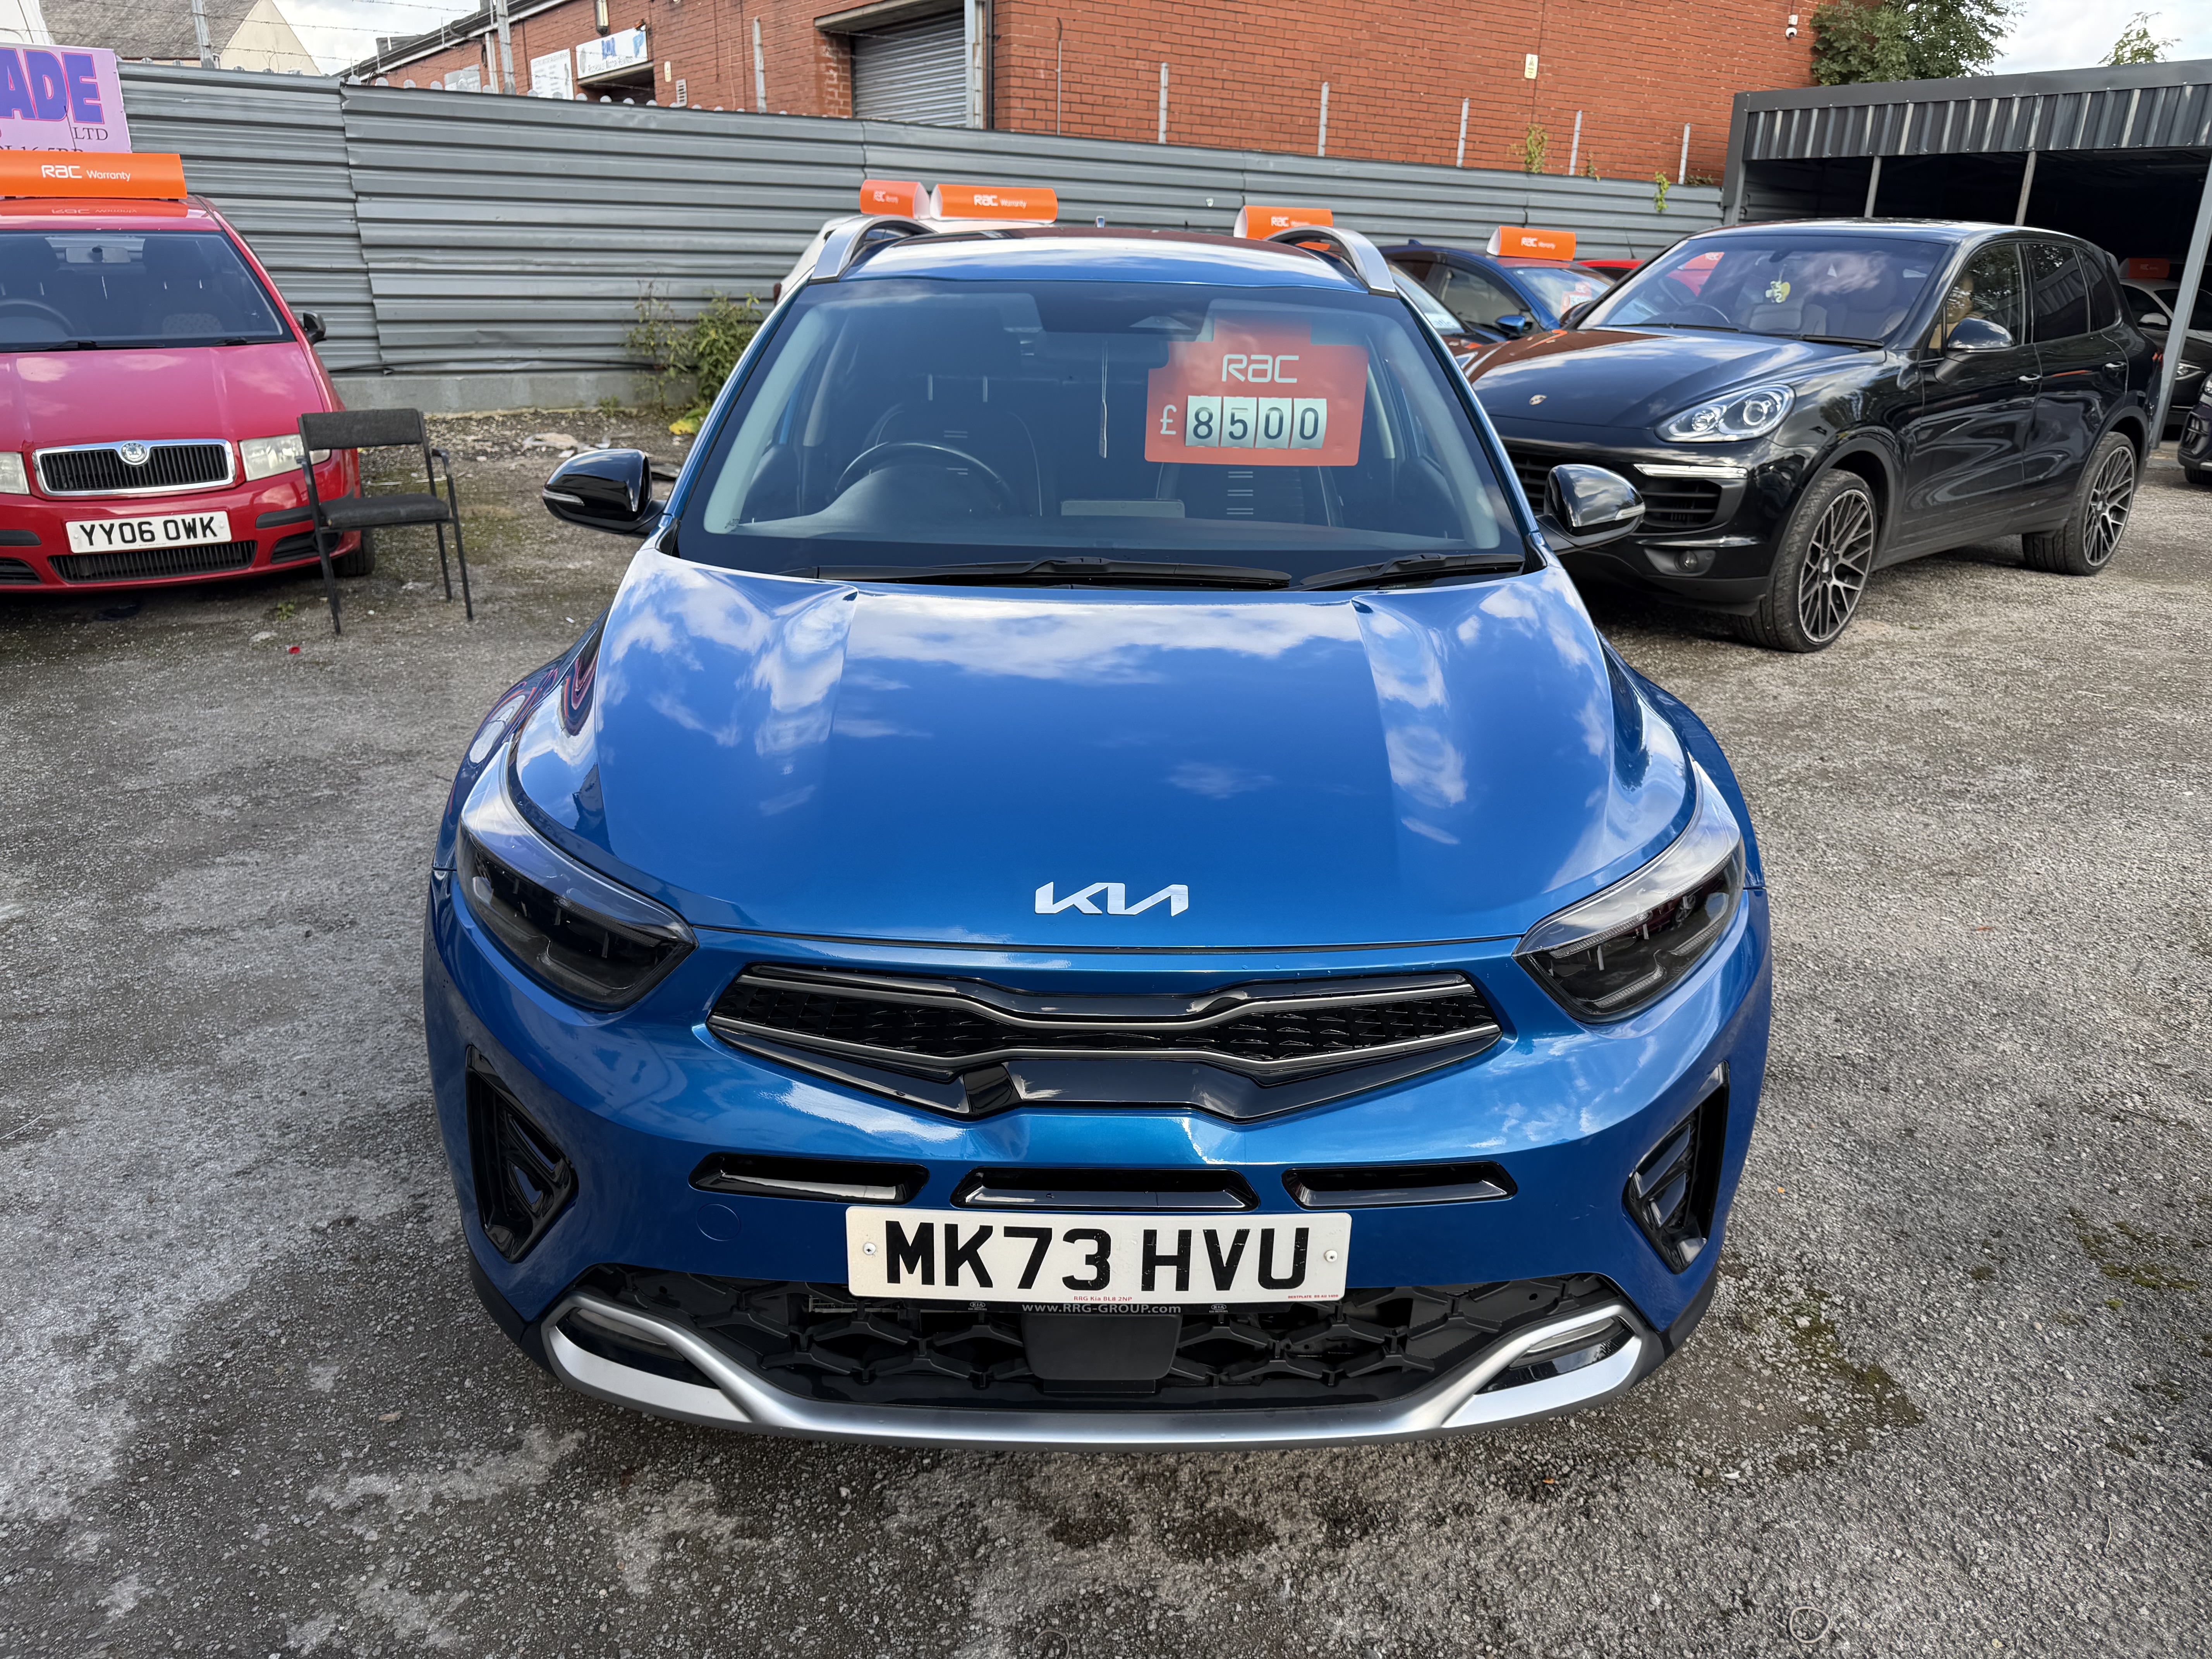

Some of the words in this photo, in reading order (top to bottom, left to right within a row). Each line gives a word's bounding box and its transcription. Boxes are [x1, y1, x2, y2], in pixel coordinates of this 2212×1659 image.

[73, 127, 108, 141] LTD
[41, 165, 82, 179] RAC
[86, 170, 131, 182] Warranty
[974, 194, 998, 206] RAC
[999, 198, 1027, 209] Warranty
[1271, 216, 1289, 227] RAC
[1221, 354, 1299, 383] RAC
[79, 521, 155, 546] YY06
[163, 516, 217, 541] OWK
[1035, 881, 1188, 917] KIA
[886, 1220, 1111, 1291] MK73
[1141, 1227, 1309, 1292] HVU
[1022, 1304, 1182, 1313] www.RRG-GROUP.com
